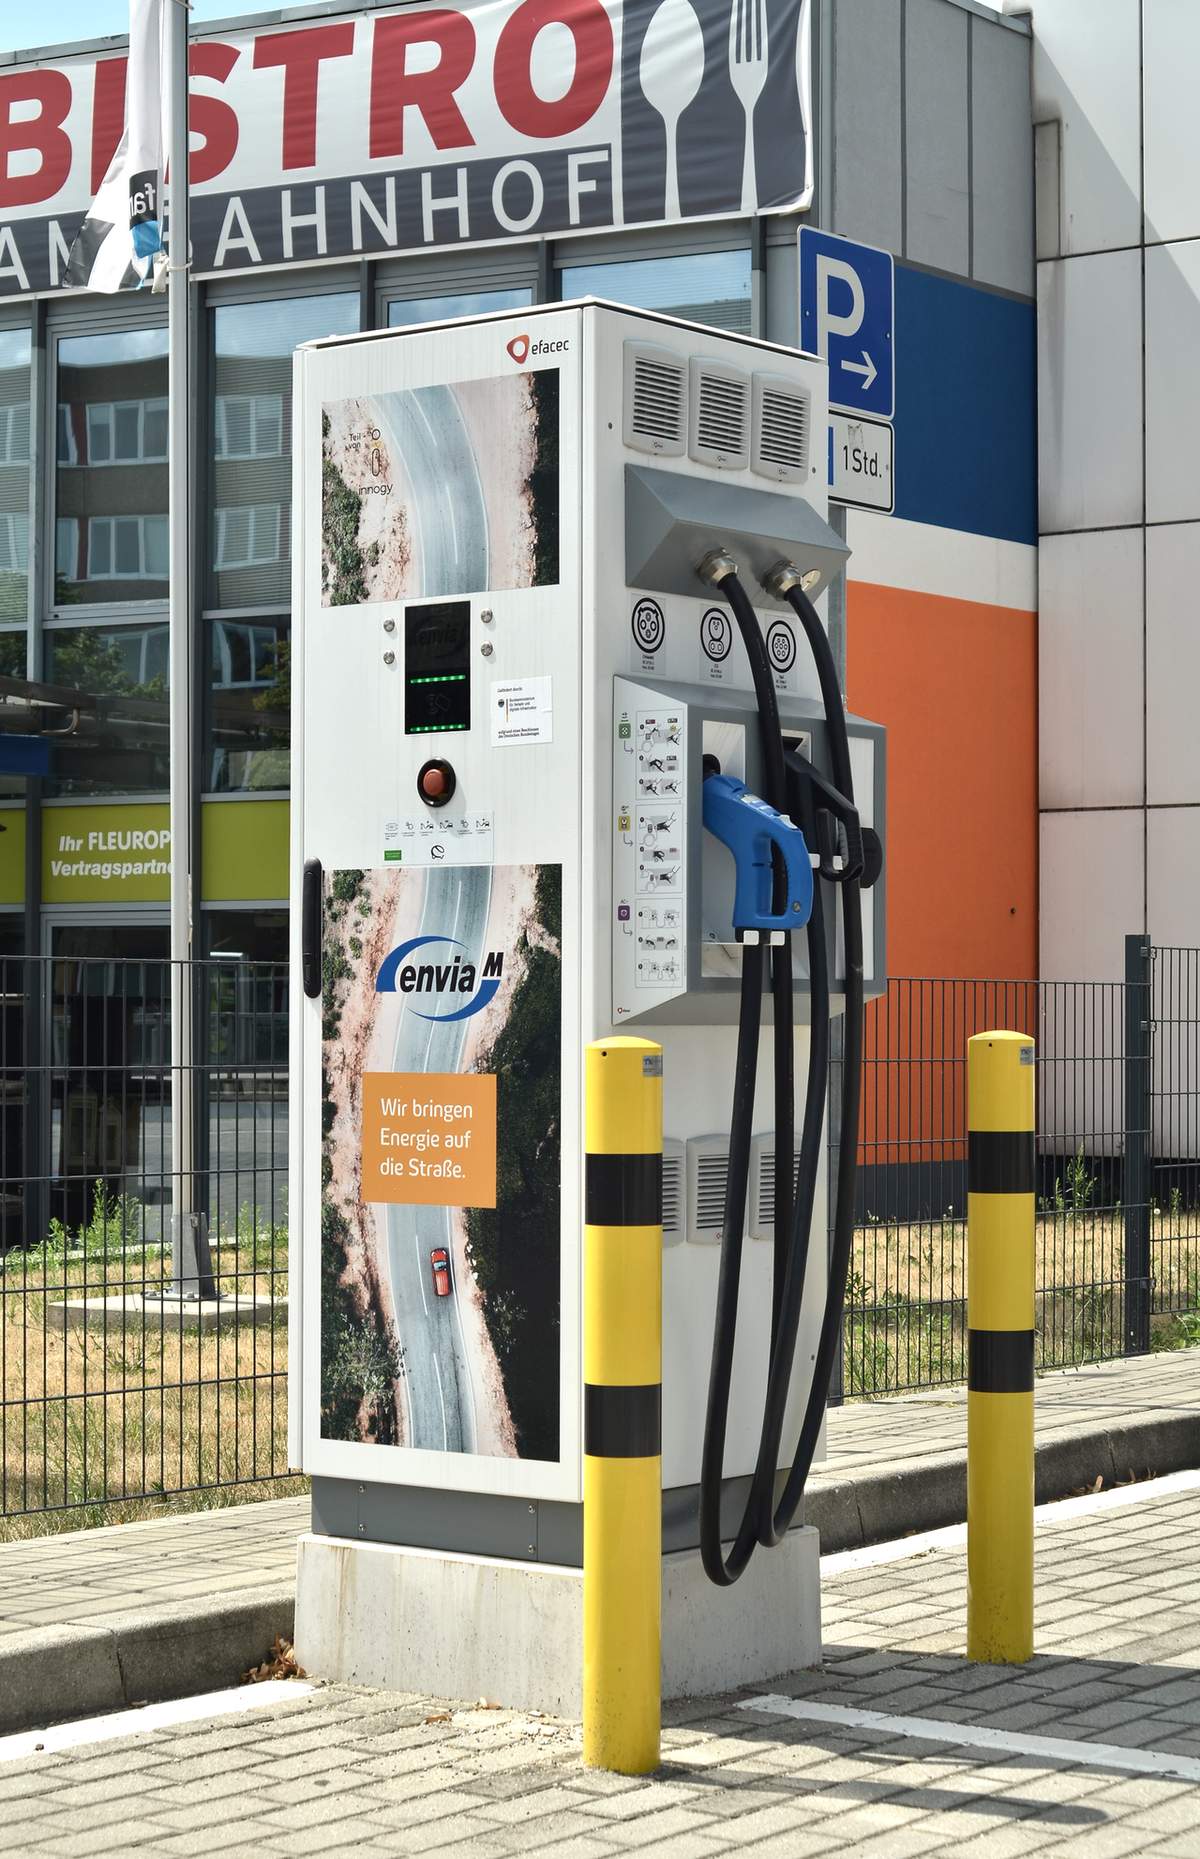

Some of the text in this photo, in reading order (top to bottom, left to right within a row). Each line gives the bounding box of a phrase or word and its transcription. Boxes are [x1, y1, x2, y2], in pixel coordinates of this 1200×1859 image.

[0, 0, 614, 206] BISTRO
[817, 254, 865, 361] P
[531, 339, 570, 355] efacec
[349, 432, 361, 441] Teil
[358, 484, 394, 496] innogy
[59, 835, 84, 852] Ihr
[380, 1098, 473, 1123] Wir bringen
[380, 1127, 472, 1151] Energie auf
[380, 1157, 466, 1179] die Straße.
